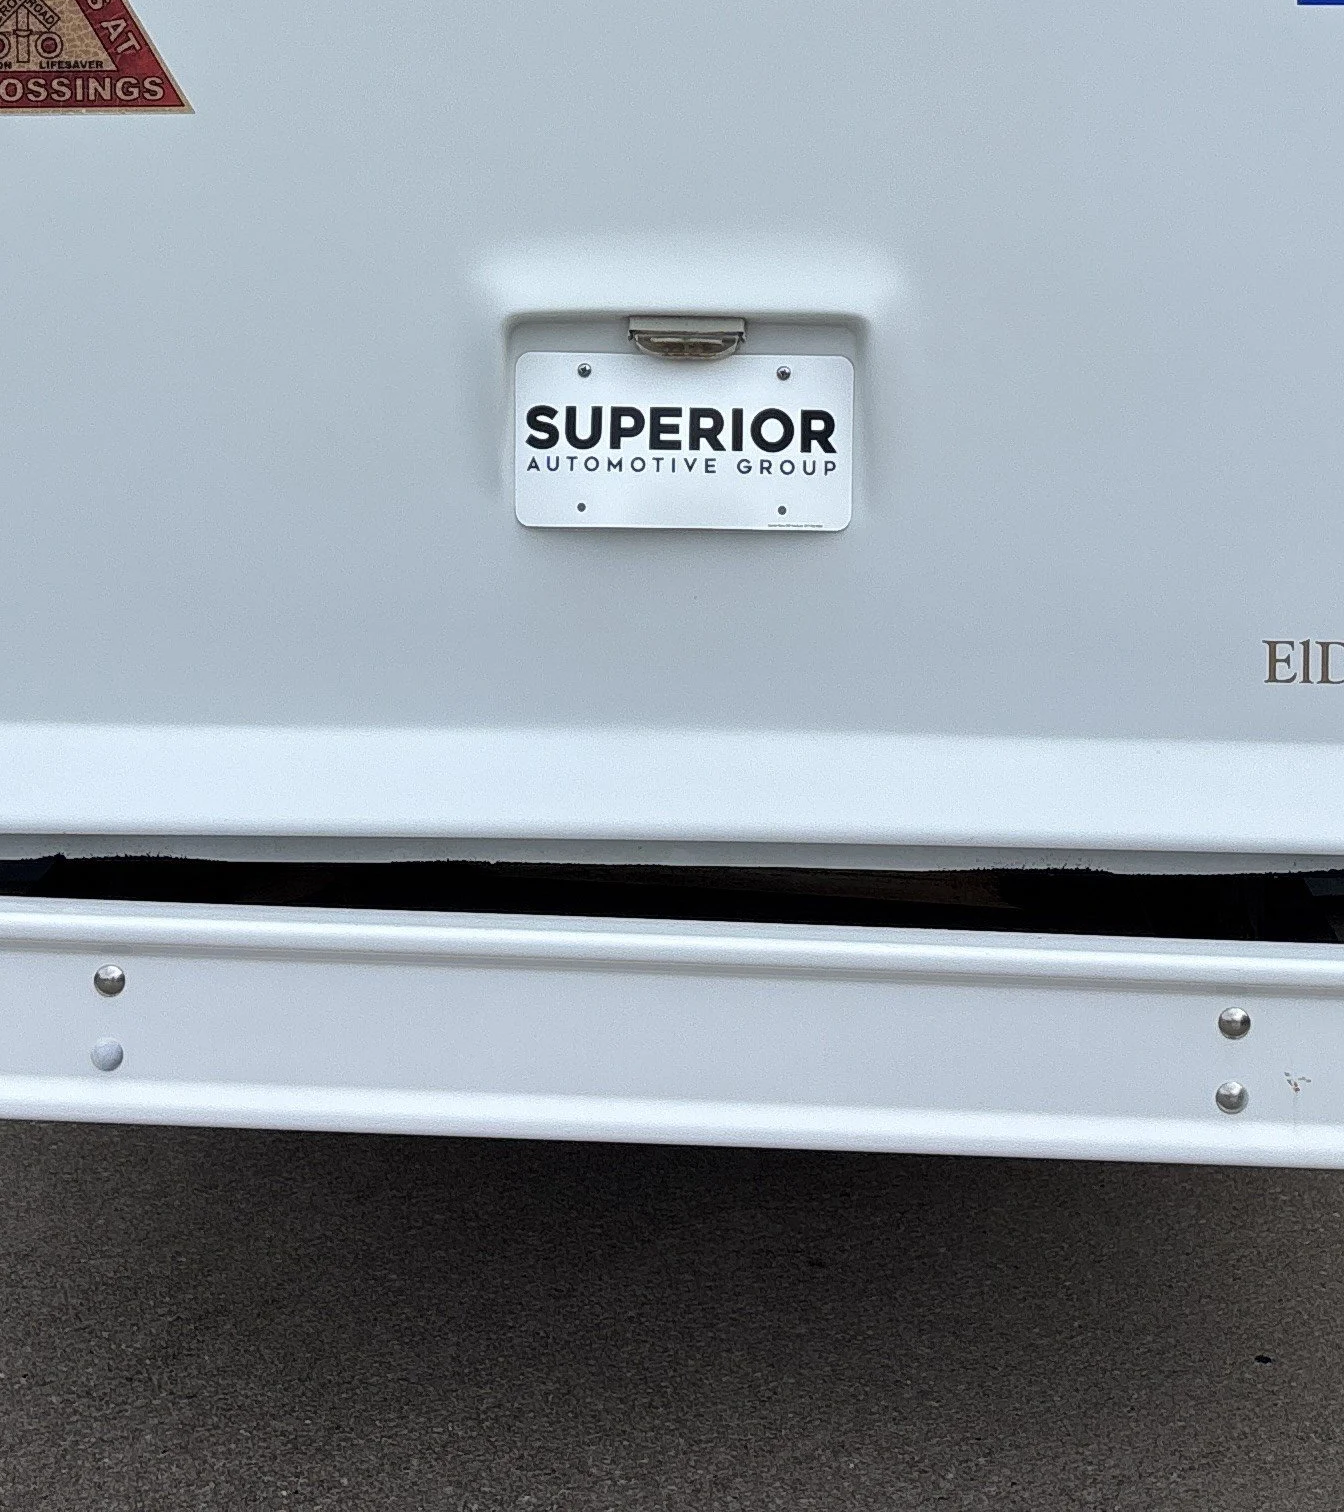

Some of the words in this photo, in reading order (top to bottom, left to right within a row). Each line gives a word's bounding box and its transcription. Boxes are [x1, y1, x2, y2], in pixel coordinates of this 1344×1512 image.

[101, 18, 141, 58] AT
[39, 60, 104, 70] LIFESAVER
[525, 404, 837, 454] SUPERIOR
[526, 455, 717, 474] AUTOMOTIVE
[736, 458, 836, 476] GROUP
